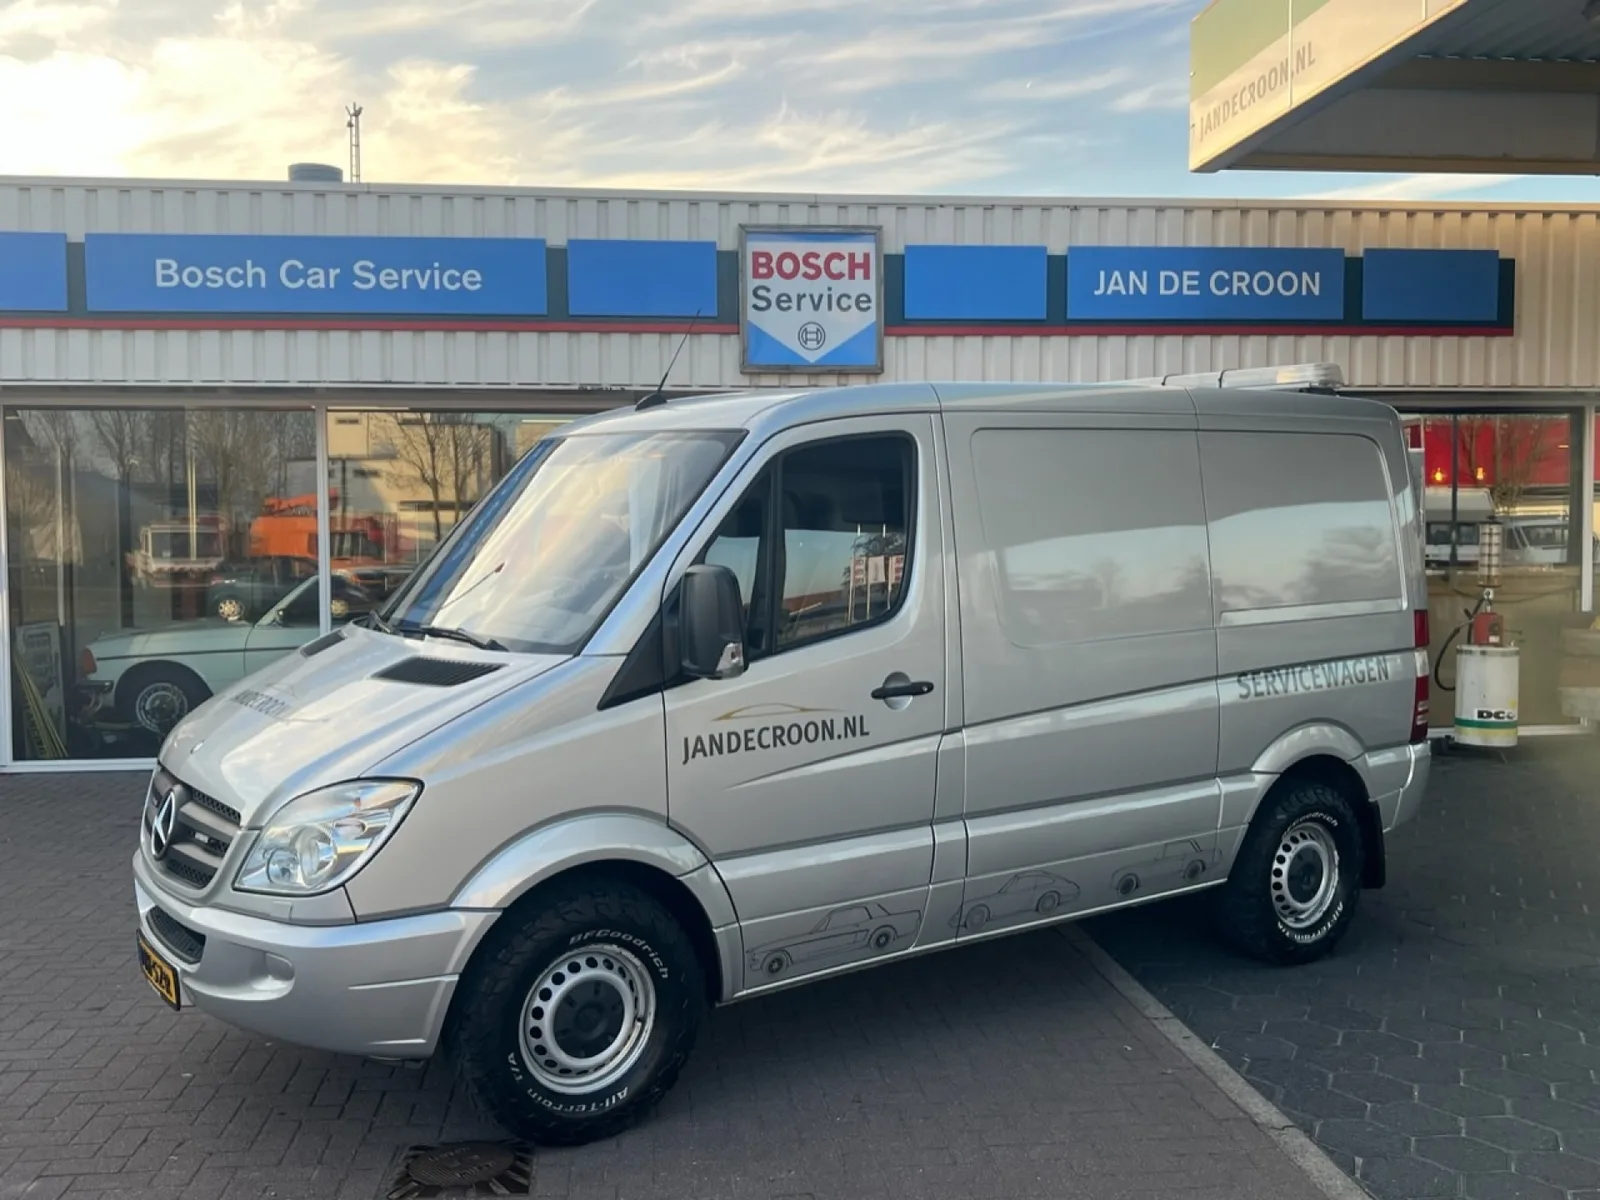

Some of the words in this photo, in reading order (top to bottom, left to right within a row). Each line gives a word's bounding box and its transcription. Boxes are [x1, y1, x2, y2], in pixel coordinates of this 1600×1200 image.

[1199, 41, 1316, 142] JANDECROON.NL
[154, 258, 267, 289] Bosch
[279, 259, 341, 289] Car
[352, 260, 483, 291] Service
[752, 251, 871, 281] BOSCH
[751, 284, 873, 312] Service
[1093, 270, 1148, 297] JAN
[1159, 271, 1199, 296] DE
[1209, 271, 1321, 297] CROON
[1237, 655, 1390, 699] SERVICEWAGEN
[682, 704, 870, 765] JANDECROON.NL
[569, 928, 669, 979] BFGoodrich
[526, 1086, 629, 1113] All-Terrain
